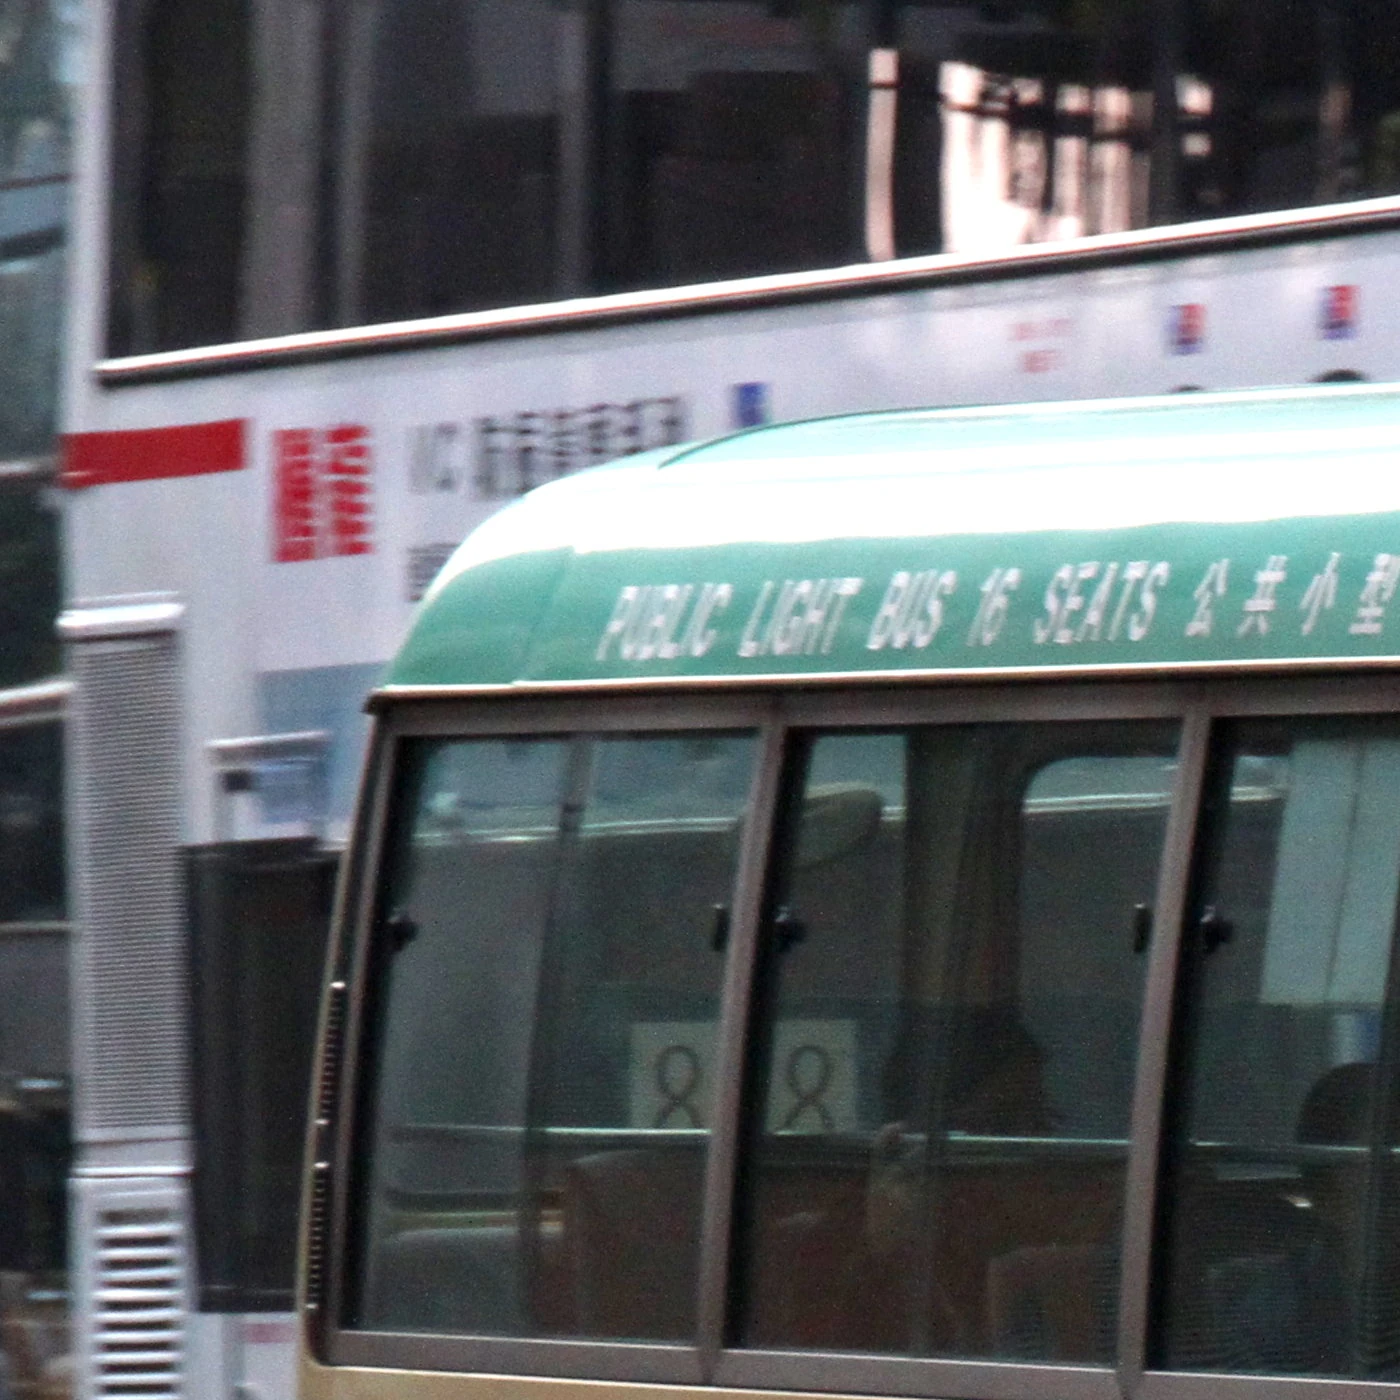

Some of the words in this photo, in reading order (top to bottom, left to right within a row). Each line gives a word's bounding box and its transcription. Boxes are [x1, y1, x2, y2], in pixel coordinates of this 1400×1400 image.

[596, 582, 733, 661] PUBLIC
[736, 576, 864, 657] LIGHT
[866, 568, 958, 650] BUS
[967, 566, 1021, 648] 16
[1033, 560, 1171, 645] SEATS
